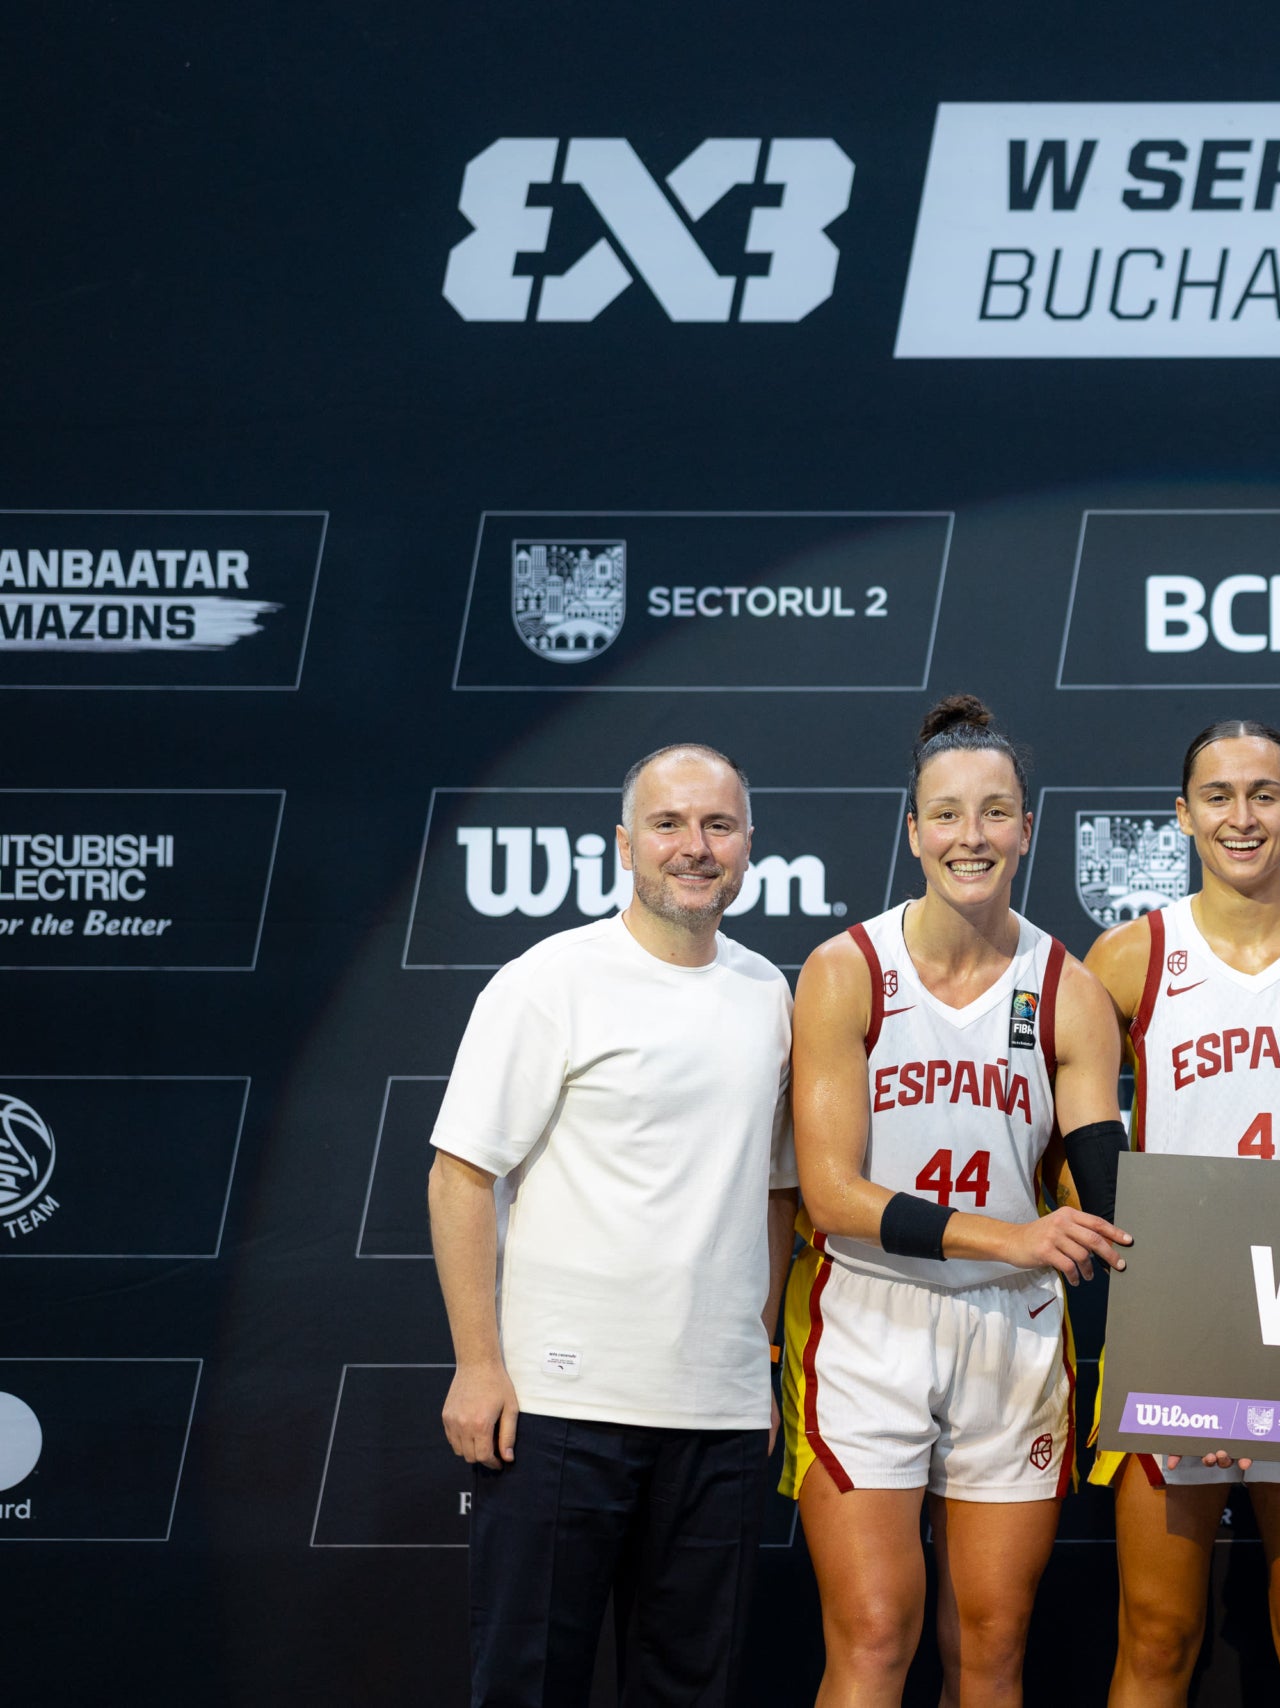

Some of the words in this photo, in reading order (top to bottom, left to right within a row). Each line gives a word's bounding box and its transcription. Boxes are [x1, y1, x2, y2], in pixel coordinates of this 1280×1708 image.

[1006, 139, 1098, 212] W
[0, 549, 249, 589] ANBAATAR
[647, 586, 856, 618] SECTORUL
[865, 586, 888, 617] 2
[0, 604, 196, 640] MAZONS
[0, 834, 174, 867] ITSUBISHI
[0, 868, 147, 901] LECTRIC
[30, 913, 74, 936] the
[83, 909, 172, 936] Better
[1013, 1023, 1033, 1035] FIBA
[874, 1057, 1032, 1125] ESPAÑA
[1237, 1112, 1276, 1159] 4
[915, 1148, 990, 1208] 44
[3, 1194, 61, 1239] TEAM
[1135, 1403, 1220, 1430] Wilson
